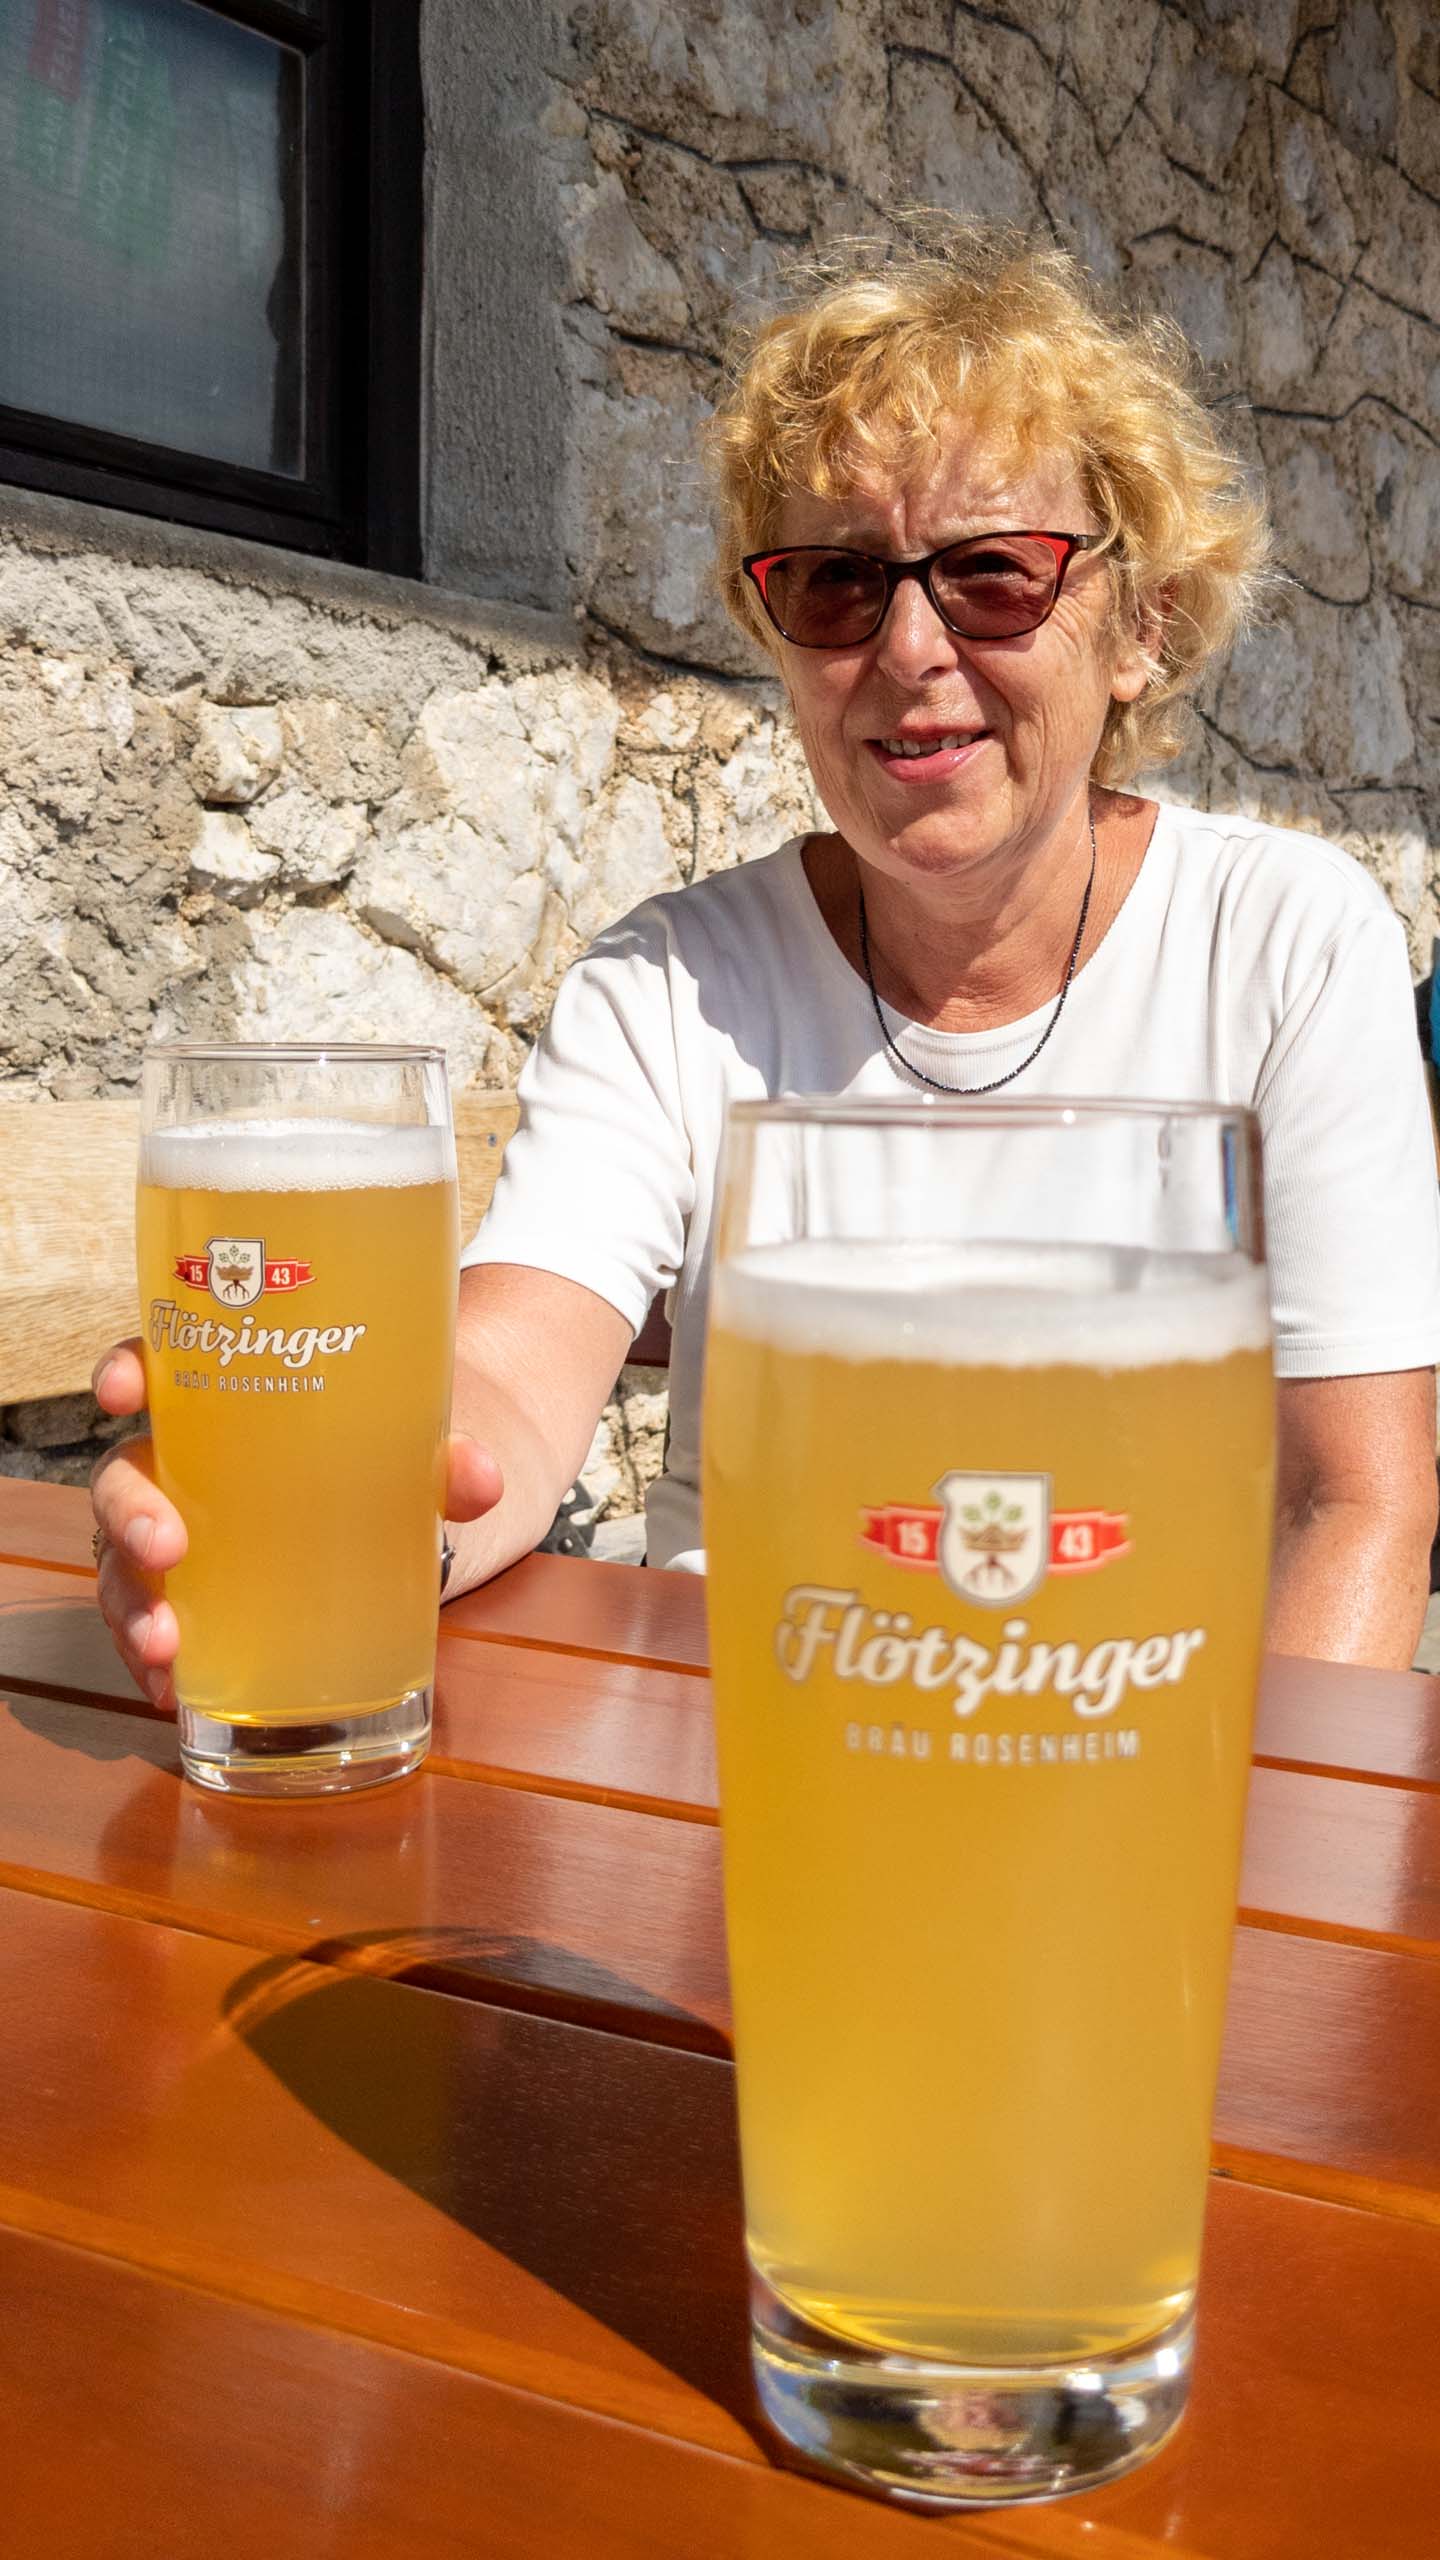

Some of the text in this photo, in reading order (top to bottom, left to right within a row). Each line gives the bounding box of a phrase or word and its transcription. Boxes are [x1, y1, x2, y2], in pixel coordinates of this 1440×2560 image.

[189, 1265, 290, 1285] 15 43
[151, 1300, 367, 1368] Flötzinger
[174, 1370, 325, 1392] BRÄU ROSENHEIM
[899, 1521, 1095, 1559] 15 43
[776, 1584, 1206, 1718] Flötzinger
[846, 1722, 1140, 1766] BRÄU ROSENHEIM
